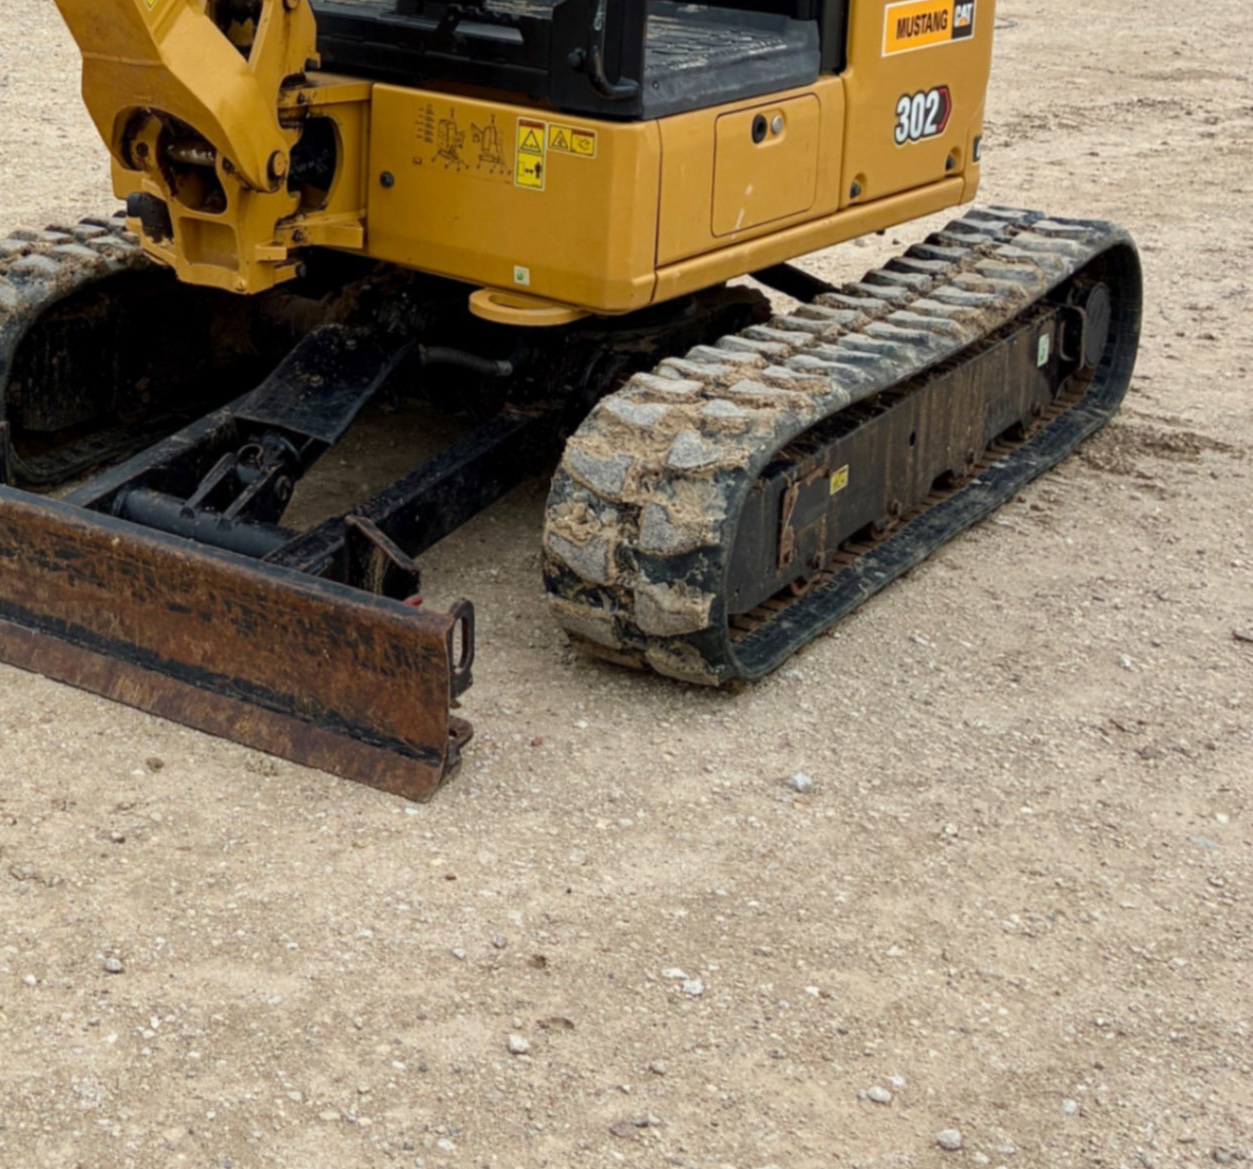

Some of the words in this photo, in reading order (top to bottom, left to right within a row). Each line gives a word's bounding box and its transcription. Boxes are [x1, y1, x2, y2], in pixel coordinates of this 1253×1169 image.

[895, 8, 949, 40] MUSTANG
[953, 2, 974, 29] CAT
[895, 89, 941, 144] 302
